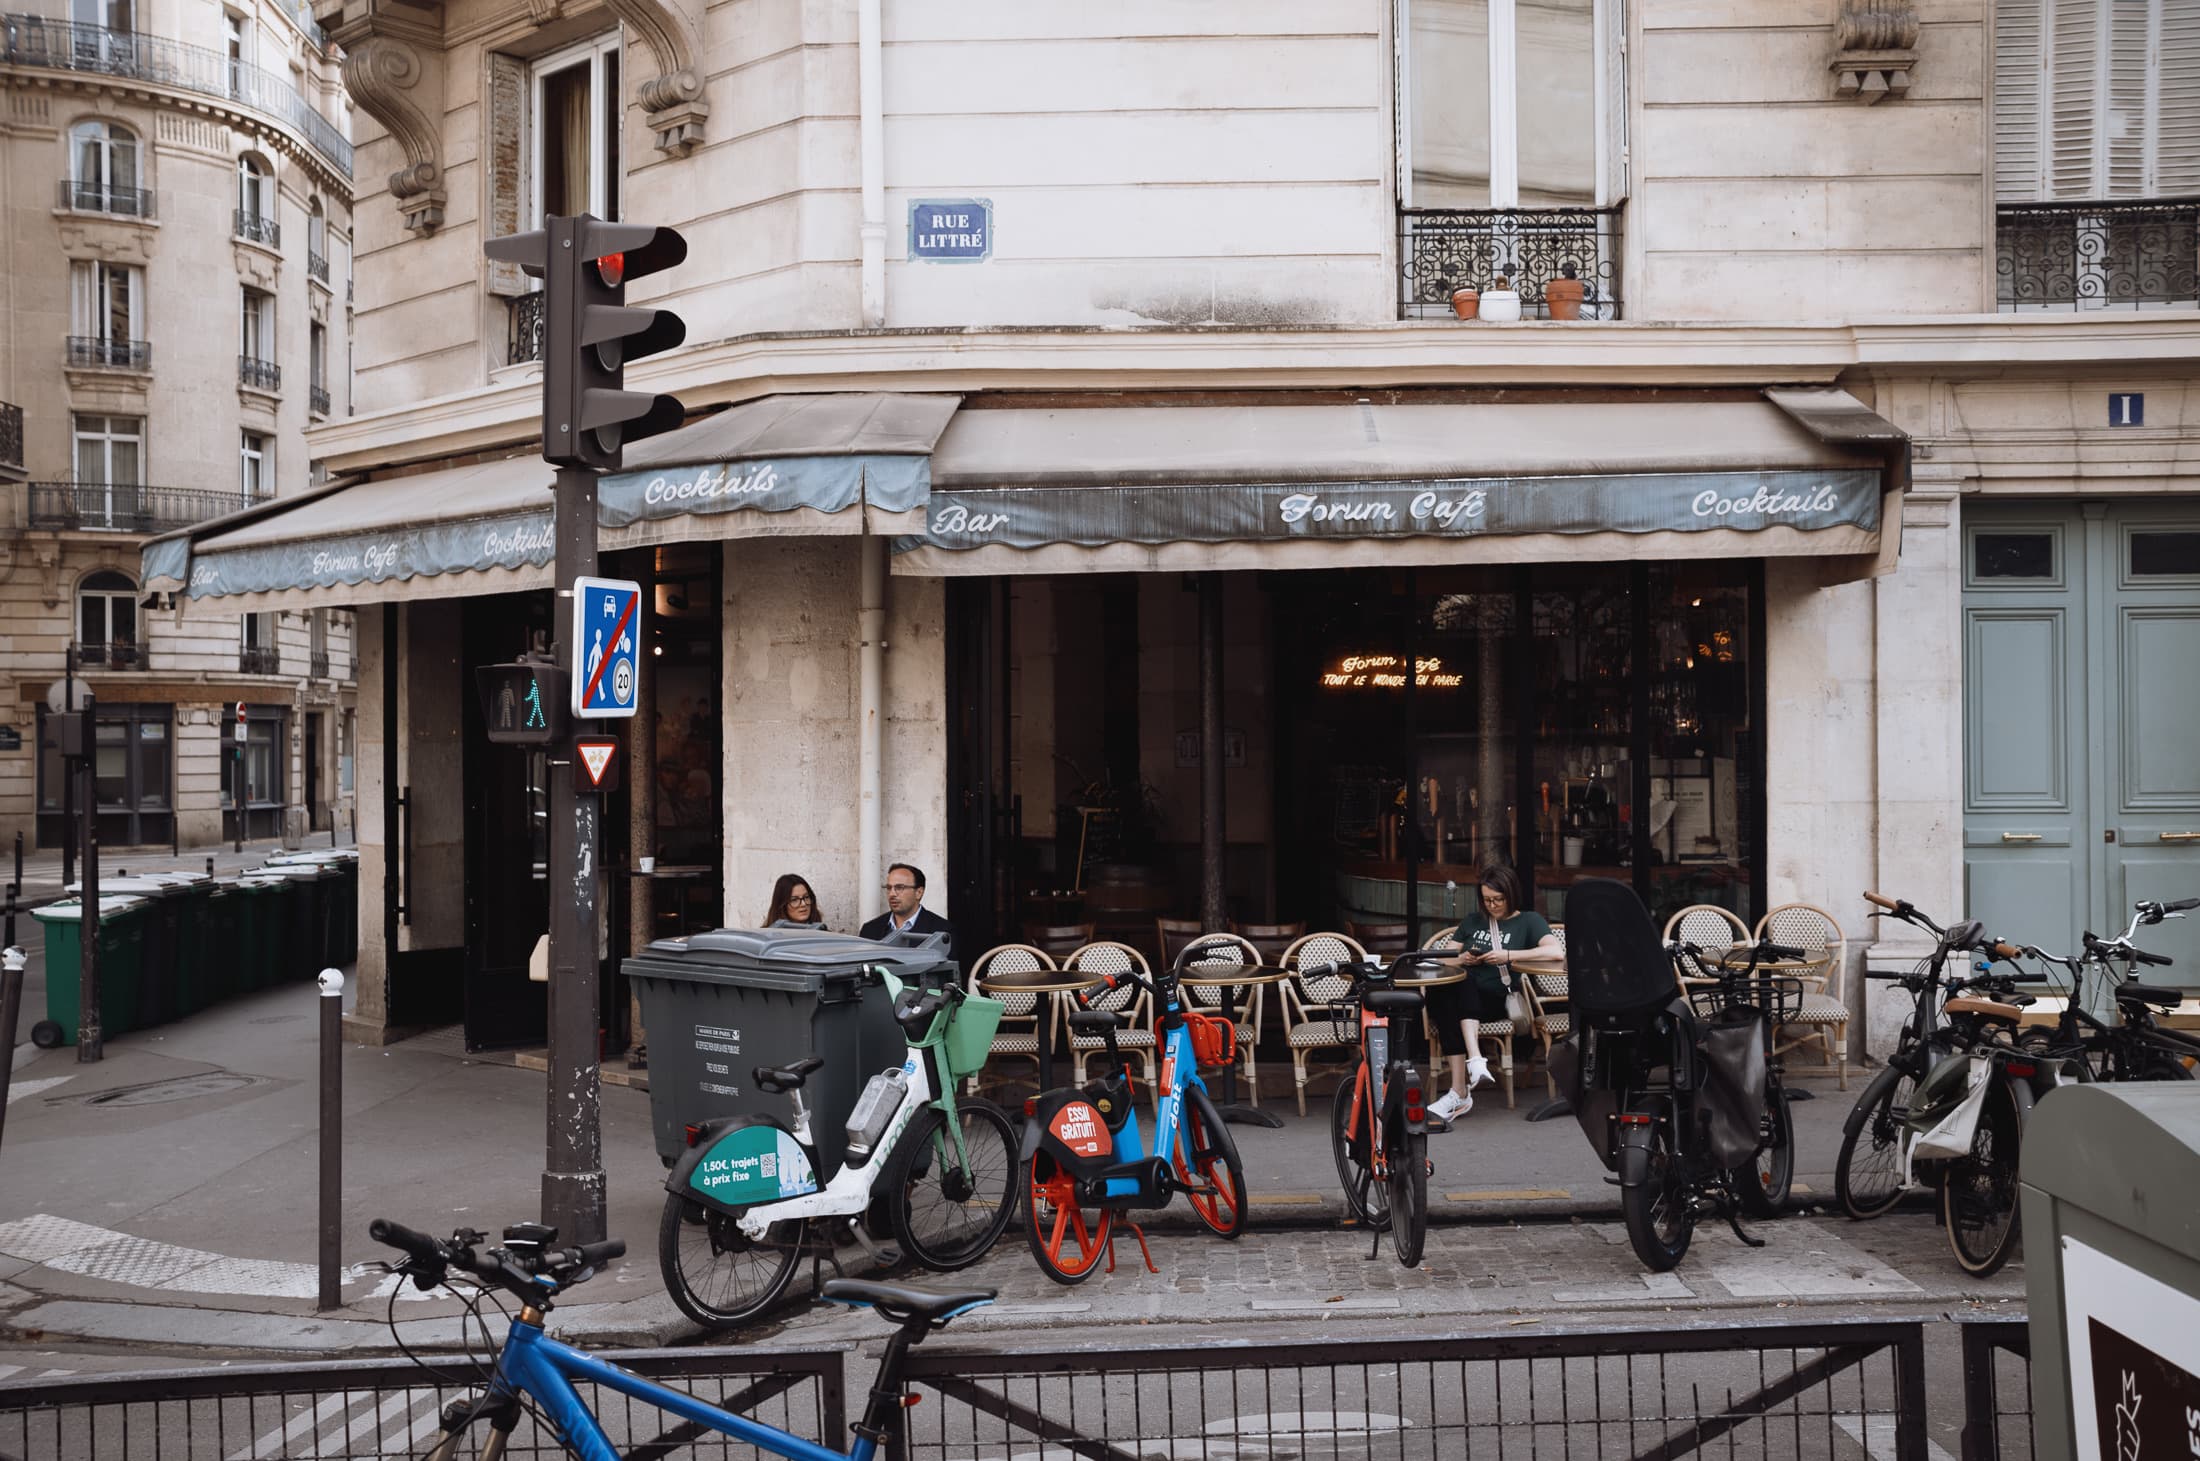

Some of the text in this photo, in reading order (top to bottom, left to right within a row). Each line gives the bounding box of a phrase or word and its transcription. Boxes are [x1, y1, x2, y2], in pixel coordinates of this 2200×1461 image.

[932, 214, 969, 229] RUE
[919, 228, 983, 248] LITTRÉ
[644, 464, 778, 505] Cocktails
[1279, 490, 1488, 529] Forum Café
[1691, 484, 1839, 518] Cocktails
[931, 505, 1010, 535] Bar
[484, 523, 554, 557] Cocktails
[312, 543, 399, 577] Forum Café
[190, 565, 220, 588] Bar
[1342, 656, 1441, 674] Forum afé
[618, 673, 628, 689] 20
[1324, 674, 1463, 687] TOUT LE MONDE EN PARLE
[1067, 1105, 1091, 1123] ESSAI
[1170, 1082, 1182, 1129] dott
[1061, 1121, 1097, 1140] GRATUIT!
[731, 1156, 759, 1170] trajets
[712, 1173, 731, 1188] prix
[732, 1171, 750, 1183] fixe
